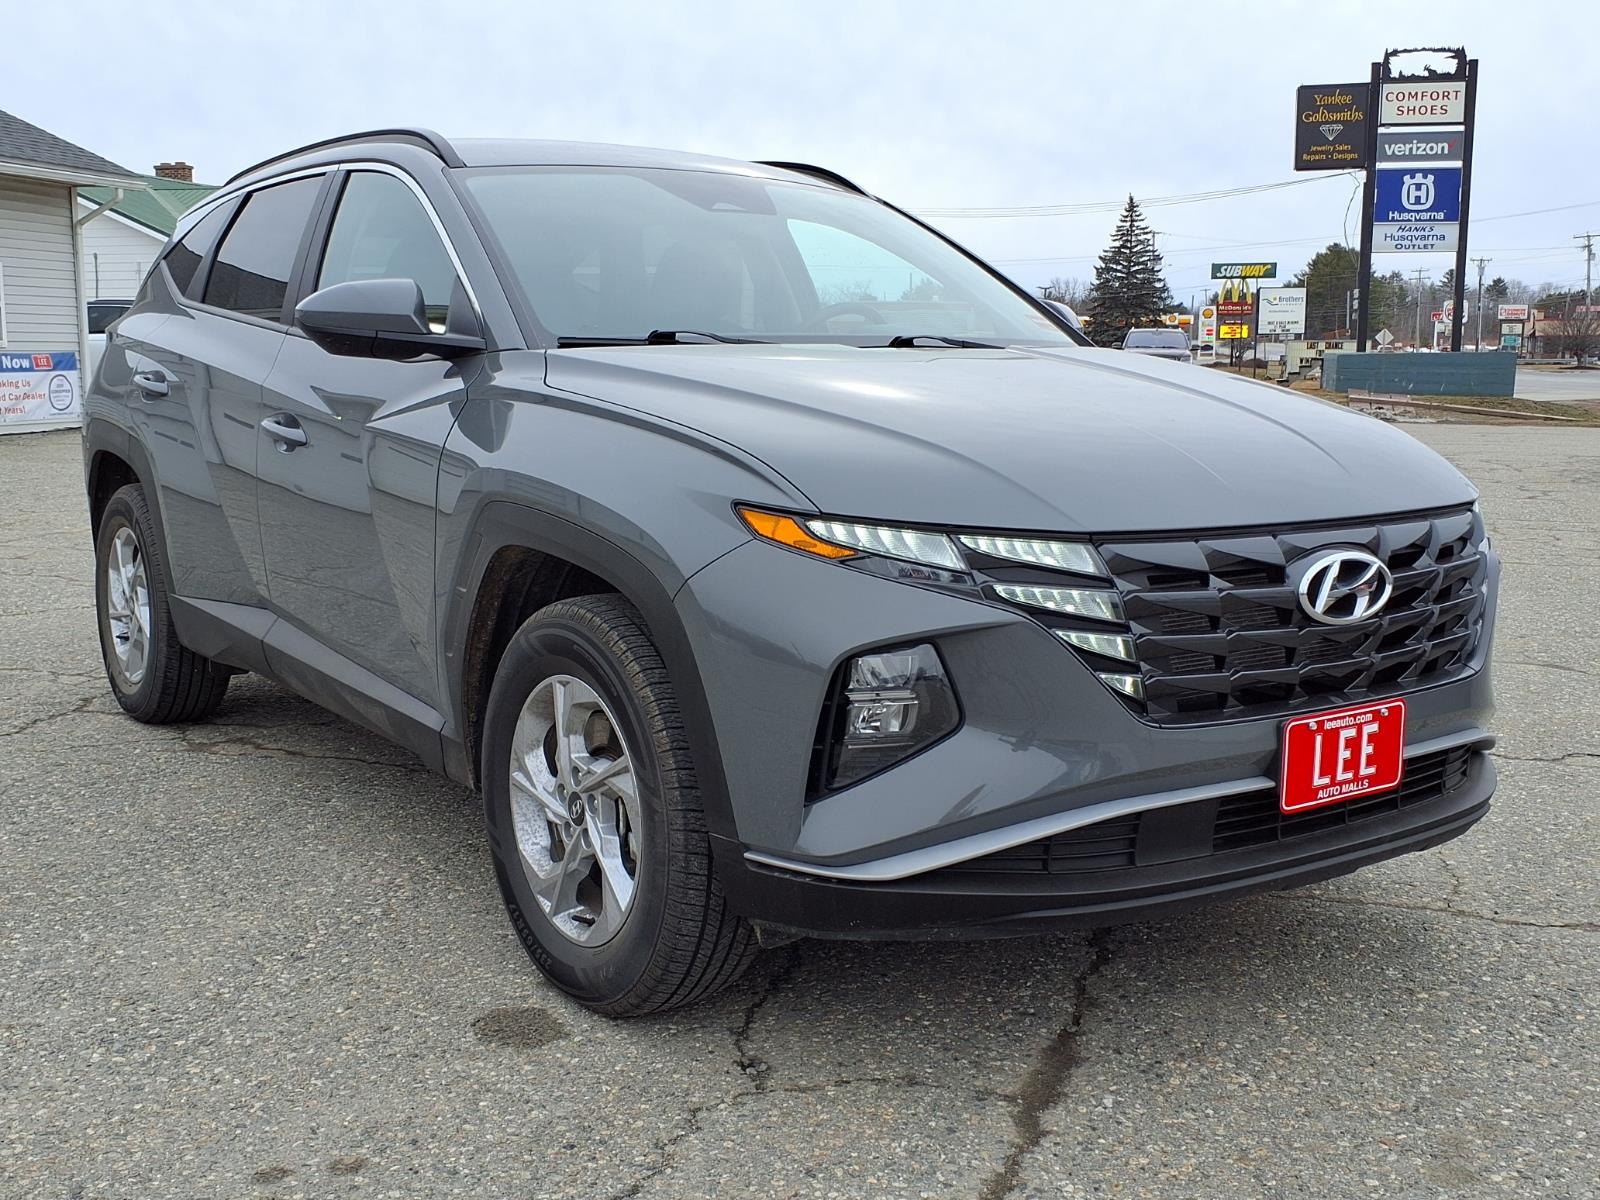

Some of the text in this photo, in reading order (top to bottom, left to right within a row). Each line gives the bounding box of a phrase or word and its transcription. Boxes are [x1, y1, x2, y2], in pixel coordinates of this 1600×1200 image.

[1313, 89, 1353, 105] Yankee
[1385, 90, 1461, 102] COMFORT
[1302, 105, 1363, 122] Goldsmiths
[1396, 105, 1448, 115] SHOES
[1384, 139, 1448, 156] verizon
[1302, 152, 1358, 161] Repairs Designs
[1389, 210, 1444, 222] Husqvarna
[1384, 233, 1446, 243] Husqvarna
[1216, 264, 1272, 277] SUBWAY
[1306, 341, 1320, 349] LAST
[1, 356, 30, 369] Now
[21, 379, 31, 388] Us
[8, 392, 21, 401] Car
[1324, 713, 1373, 730] leeauto.com
[1312, 721, 1379, 788] LEE
[1317, 779, 1369, 799] AUTO MALLS
